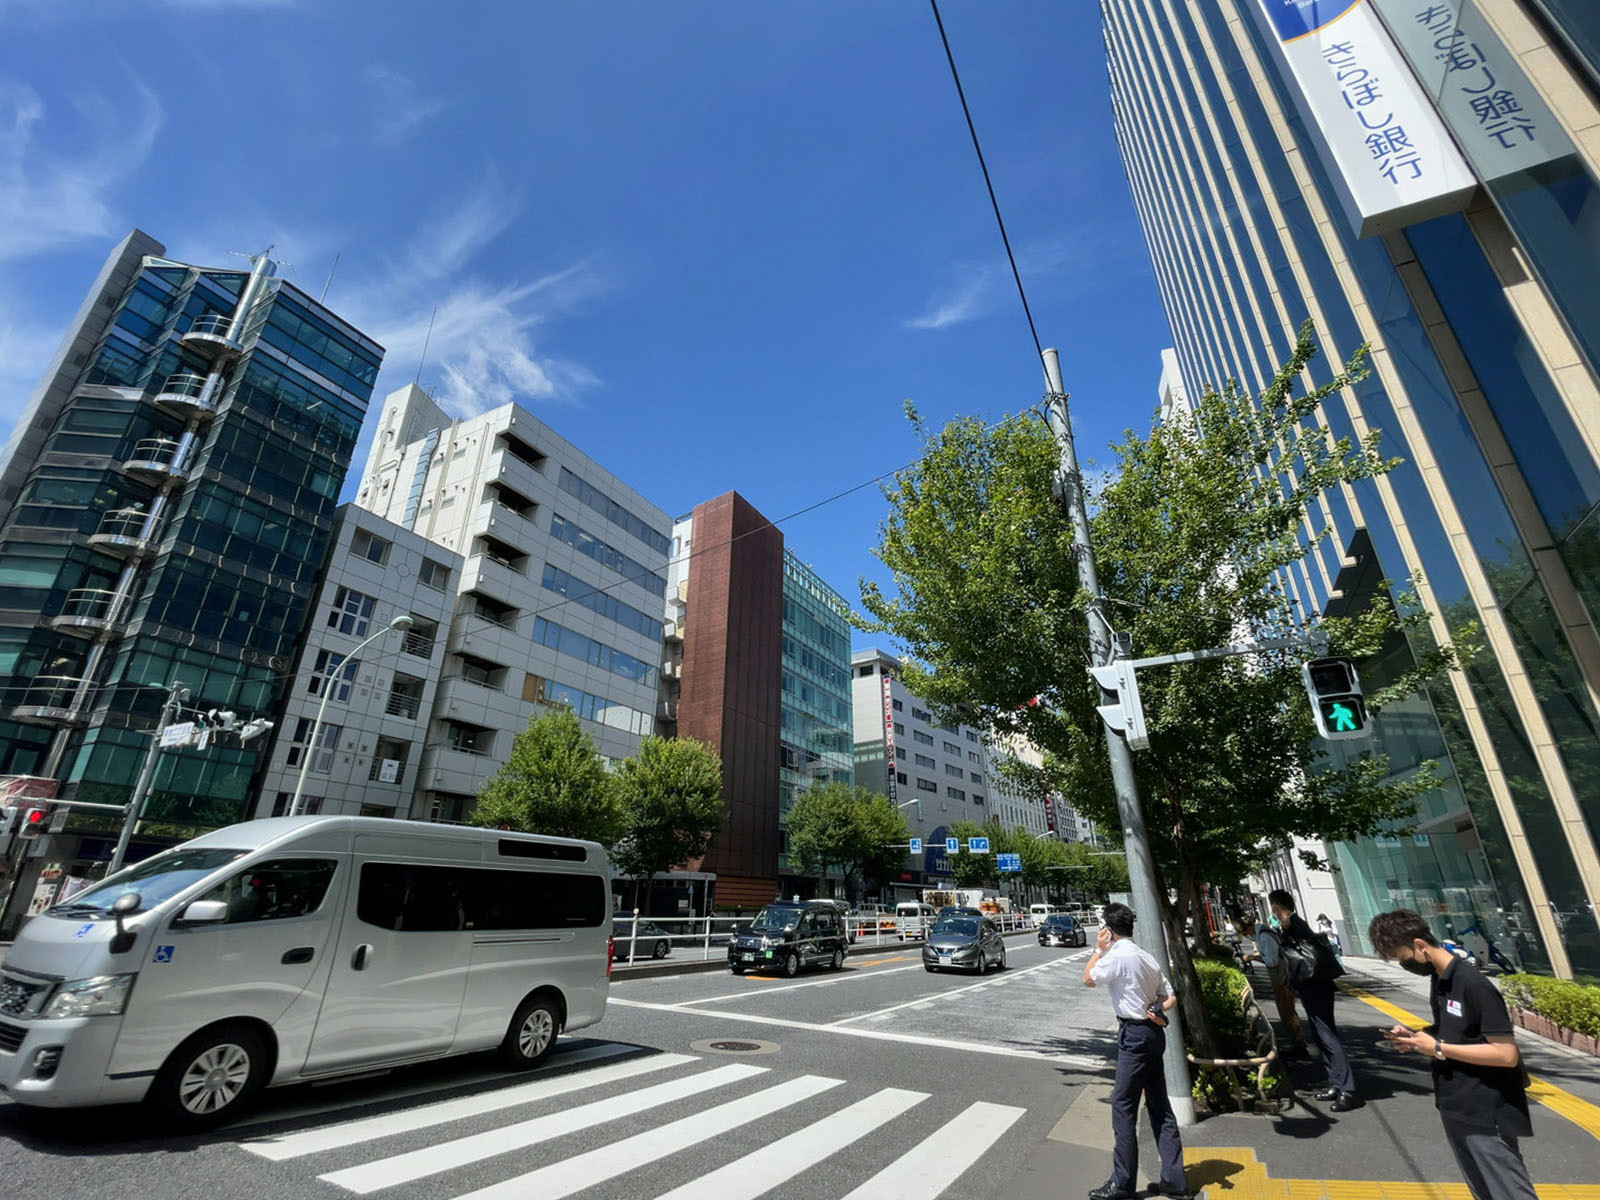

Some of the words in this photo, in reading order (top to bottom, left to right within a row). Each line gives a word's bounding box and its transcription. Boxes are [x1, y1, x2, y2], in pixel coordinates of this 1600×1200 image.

[1321, 41, 1422, 185] きらぼし銀行
